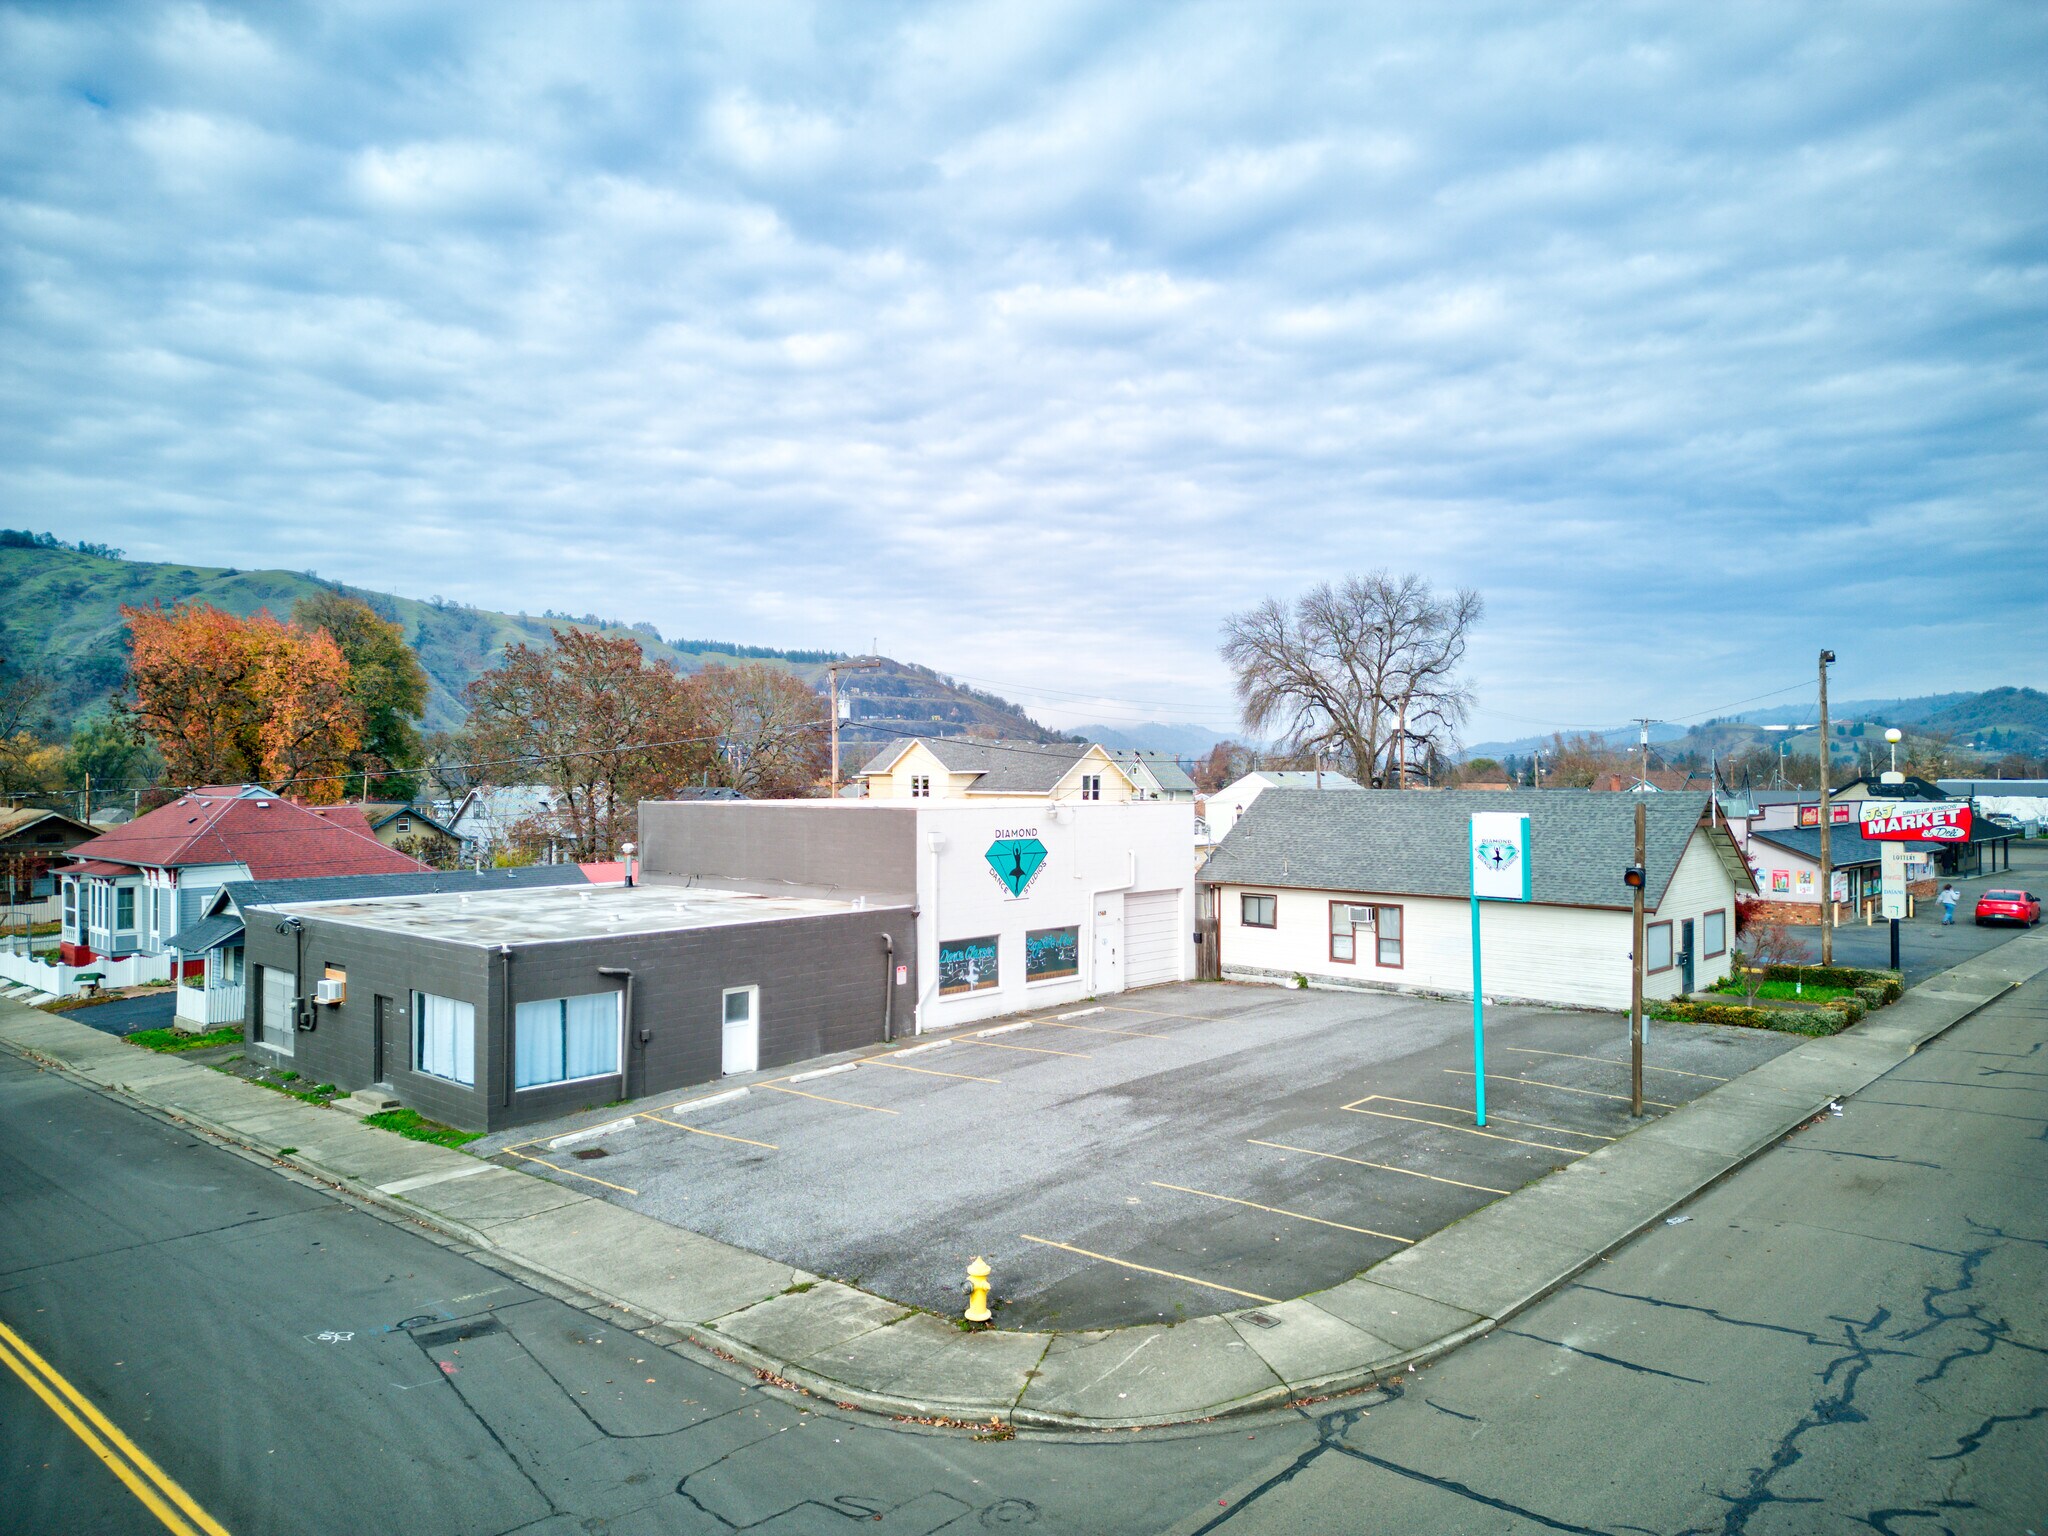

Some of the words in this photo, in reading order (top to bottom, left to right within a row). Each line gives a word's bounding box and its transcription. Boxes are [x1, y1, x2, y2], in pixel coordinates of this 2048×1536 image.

[1902, 808, 1930, 816] DRIVE-UP
[1931, 804, 1958, 812] WINDOW
[1868, 809, 1961, 835] MARKET
[995, 828, 1038, 839] DIAMOND
[1936, 827, 1958, 837] Deli
[988, 867, 1009, 894] DANCE
[1023, 860, 1047, 894] STUDIOS
[939, 948, 964, 963] Dance
[964, 945, 996, 960] Classes
